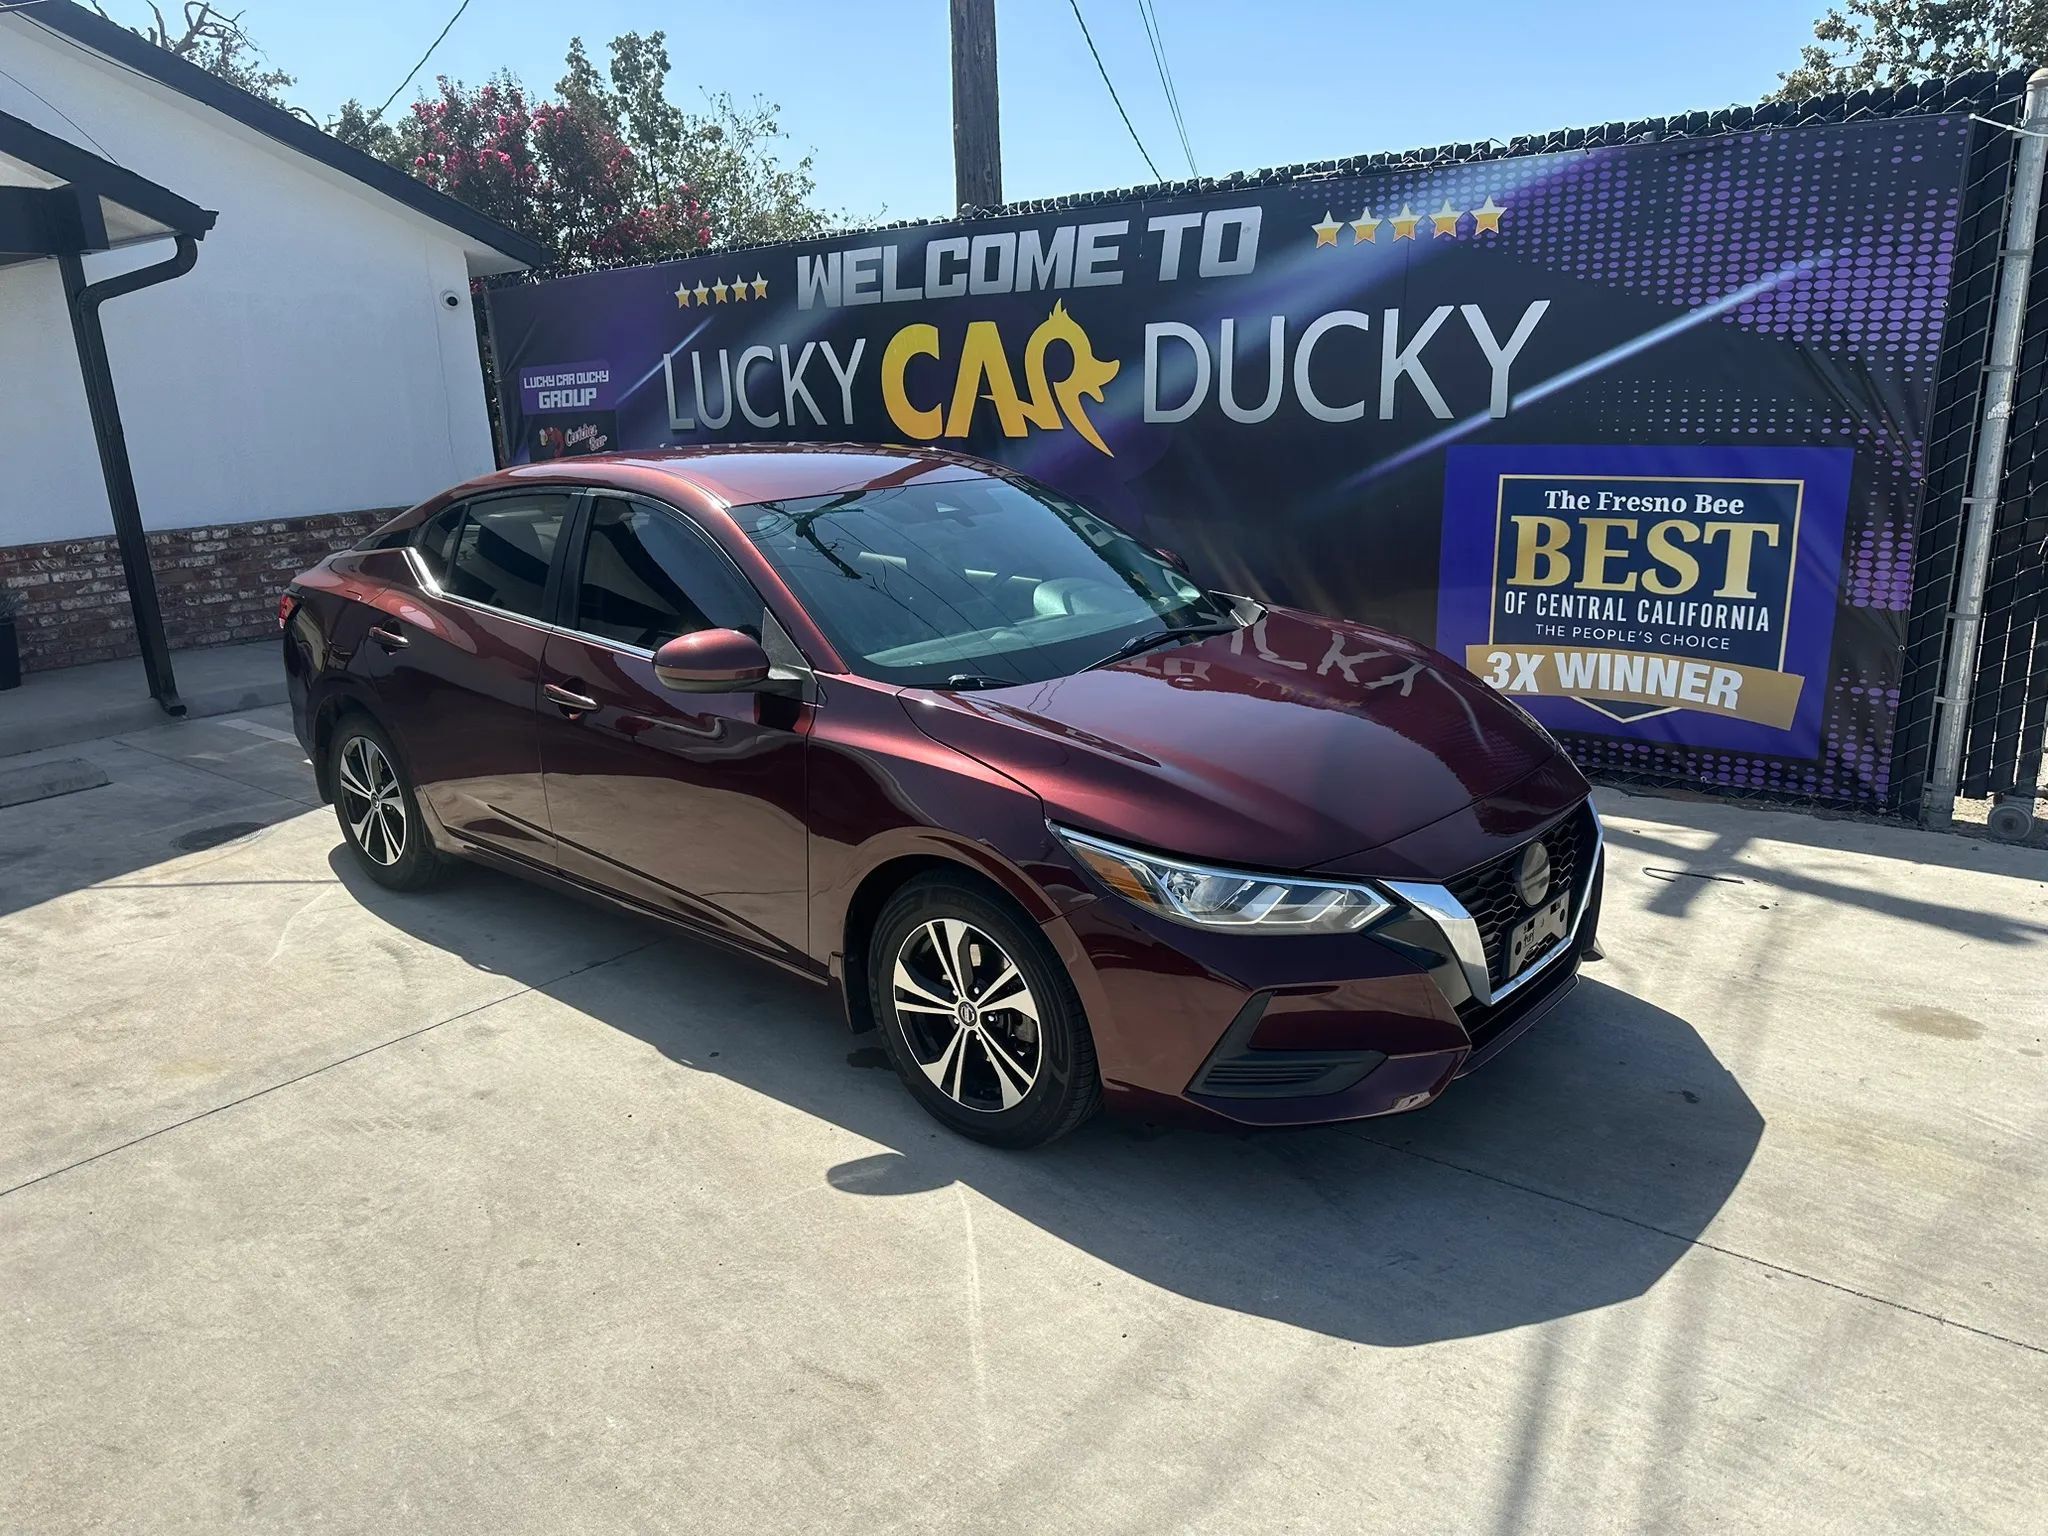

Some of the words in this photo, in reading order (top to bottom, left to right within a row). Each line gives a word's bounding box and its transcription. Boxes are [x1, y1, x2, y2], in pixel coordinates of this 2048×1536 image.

[797, 219, 1130, 310] WELCOME
[1148, 205, 1263, 282] TO
[523, 375, 555, 389] LUCKY
[556, 373, 576, 386] CAR
[576, 370, 609, 385] DUCKY
[538, 387, 597, 409] GROUP
[663, 337, 867, 431] LUCKY
[881, 298, 1120, 458] CAR
[1144, 299, 1551, 424] DUCKY
[1544, 489, 1591, 511] The
[1596, 491, 1688, 514] Fresno
[1693, 493, 1745, 515] Bee
[1506, 515, 1780, 600] BEST
[1504, 590, 1528, 615] OF
[1536, 592, 1627, 623] CENTRAL
[1637, 598, 1770, 632] CALIFORNIA
[1535, 623, 1566, 638] THE
[1660, 633, 1731, 651] CHOICE
[1482, 651, 1546, 694] 3X
[1553, 651, 1744, 711] WINNER
